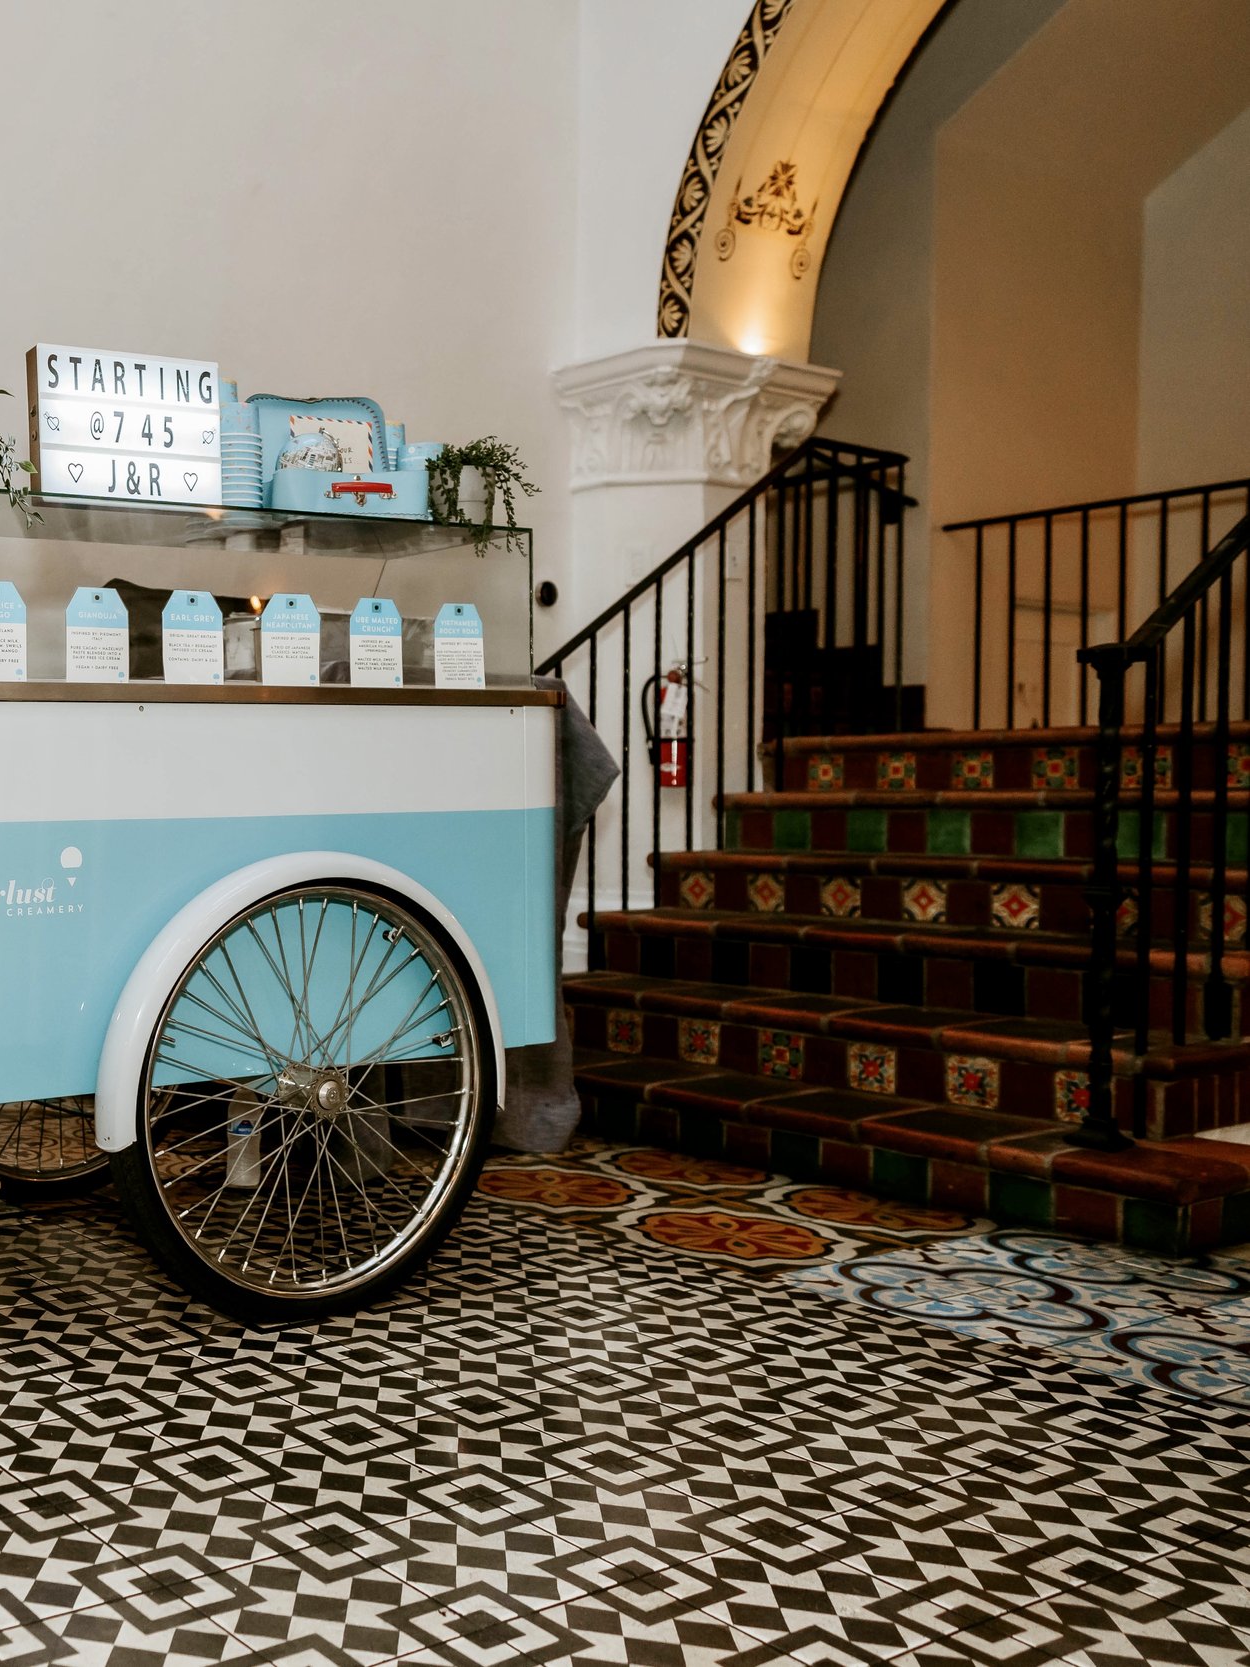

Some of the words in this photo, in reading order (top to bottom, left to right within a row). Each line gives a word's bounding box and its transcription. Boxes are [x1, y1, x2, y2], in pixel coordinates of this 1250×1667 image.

[46, 353, 213, 405] STARTING
[107, 459, 162, 497] J&R
[170, 612, 191, 621] EARL
[193, 614, 215, 623] GREY
[272, 612, 311, 621] JAPANESE
[355, 616, 369, 624] UBE
[371, 616, 399, 625] MALTED
[6, 904, 85, 917] CREAMERY
